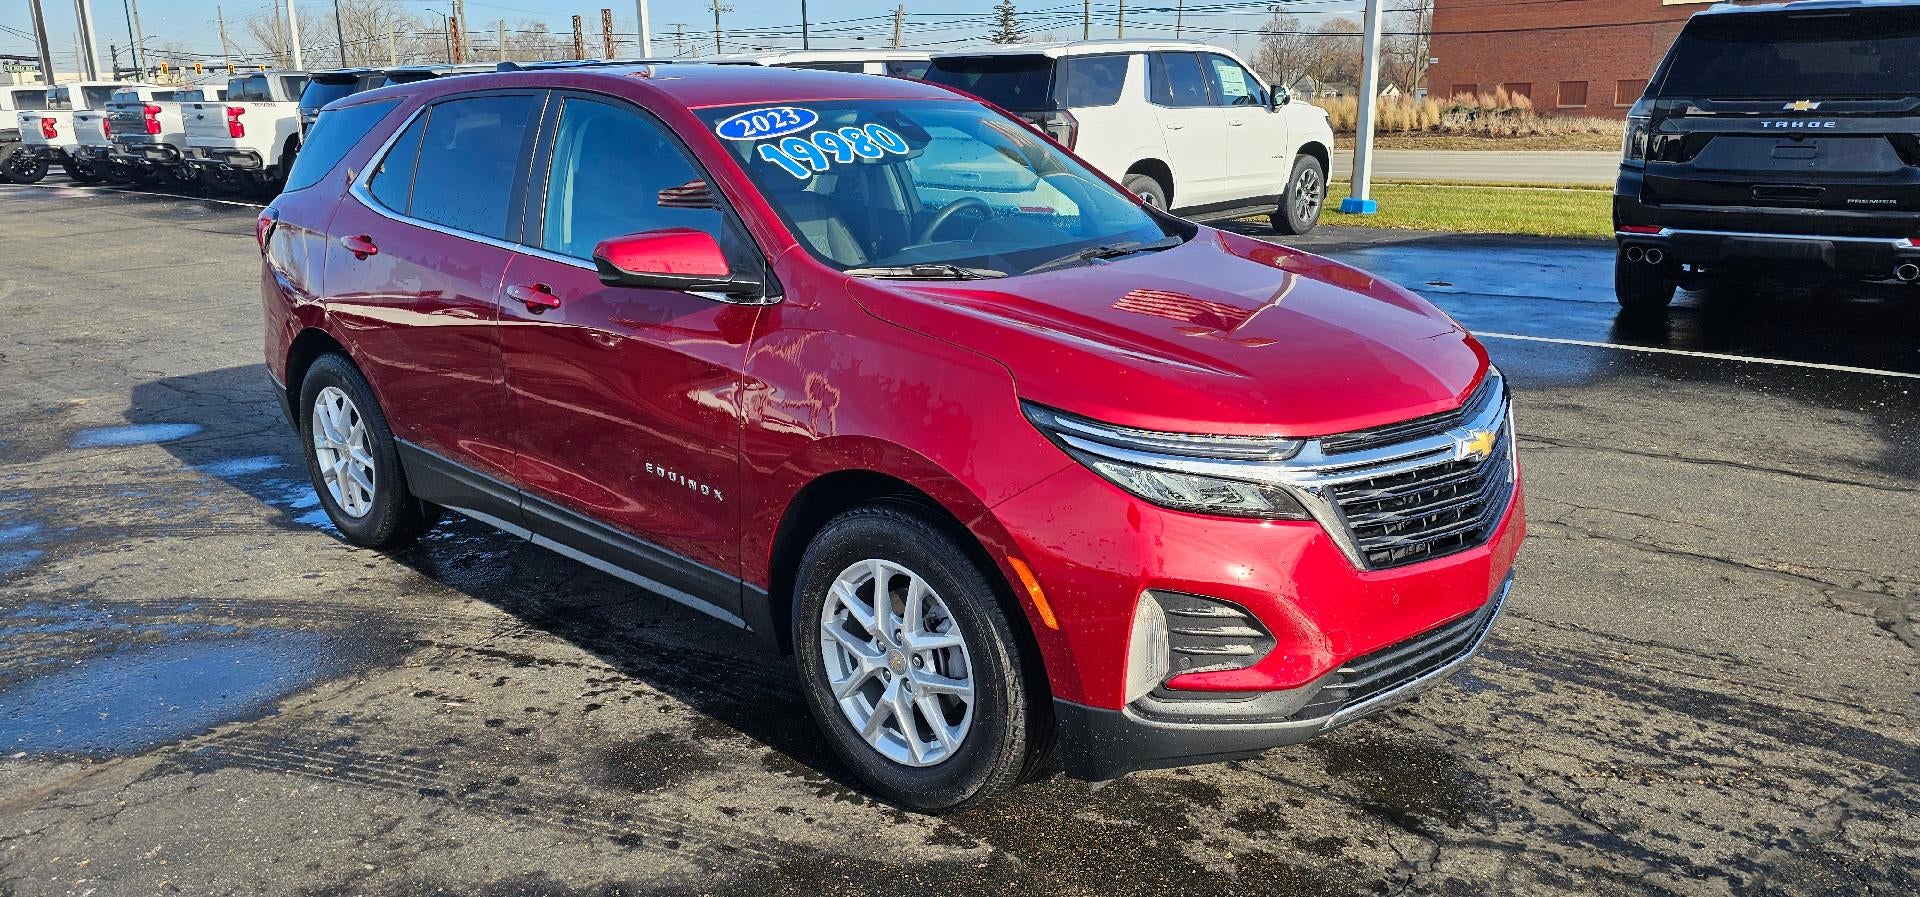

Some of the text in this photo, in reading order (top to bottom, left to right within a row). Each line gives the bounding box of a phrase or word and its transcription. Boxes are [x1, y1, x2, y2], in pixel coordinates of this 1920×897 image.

[735, 108, 801, 136] 2023
[757, 123, 909, 180] 19980
[646, 463, 723, 501] EQUINOX
